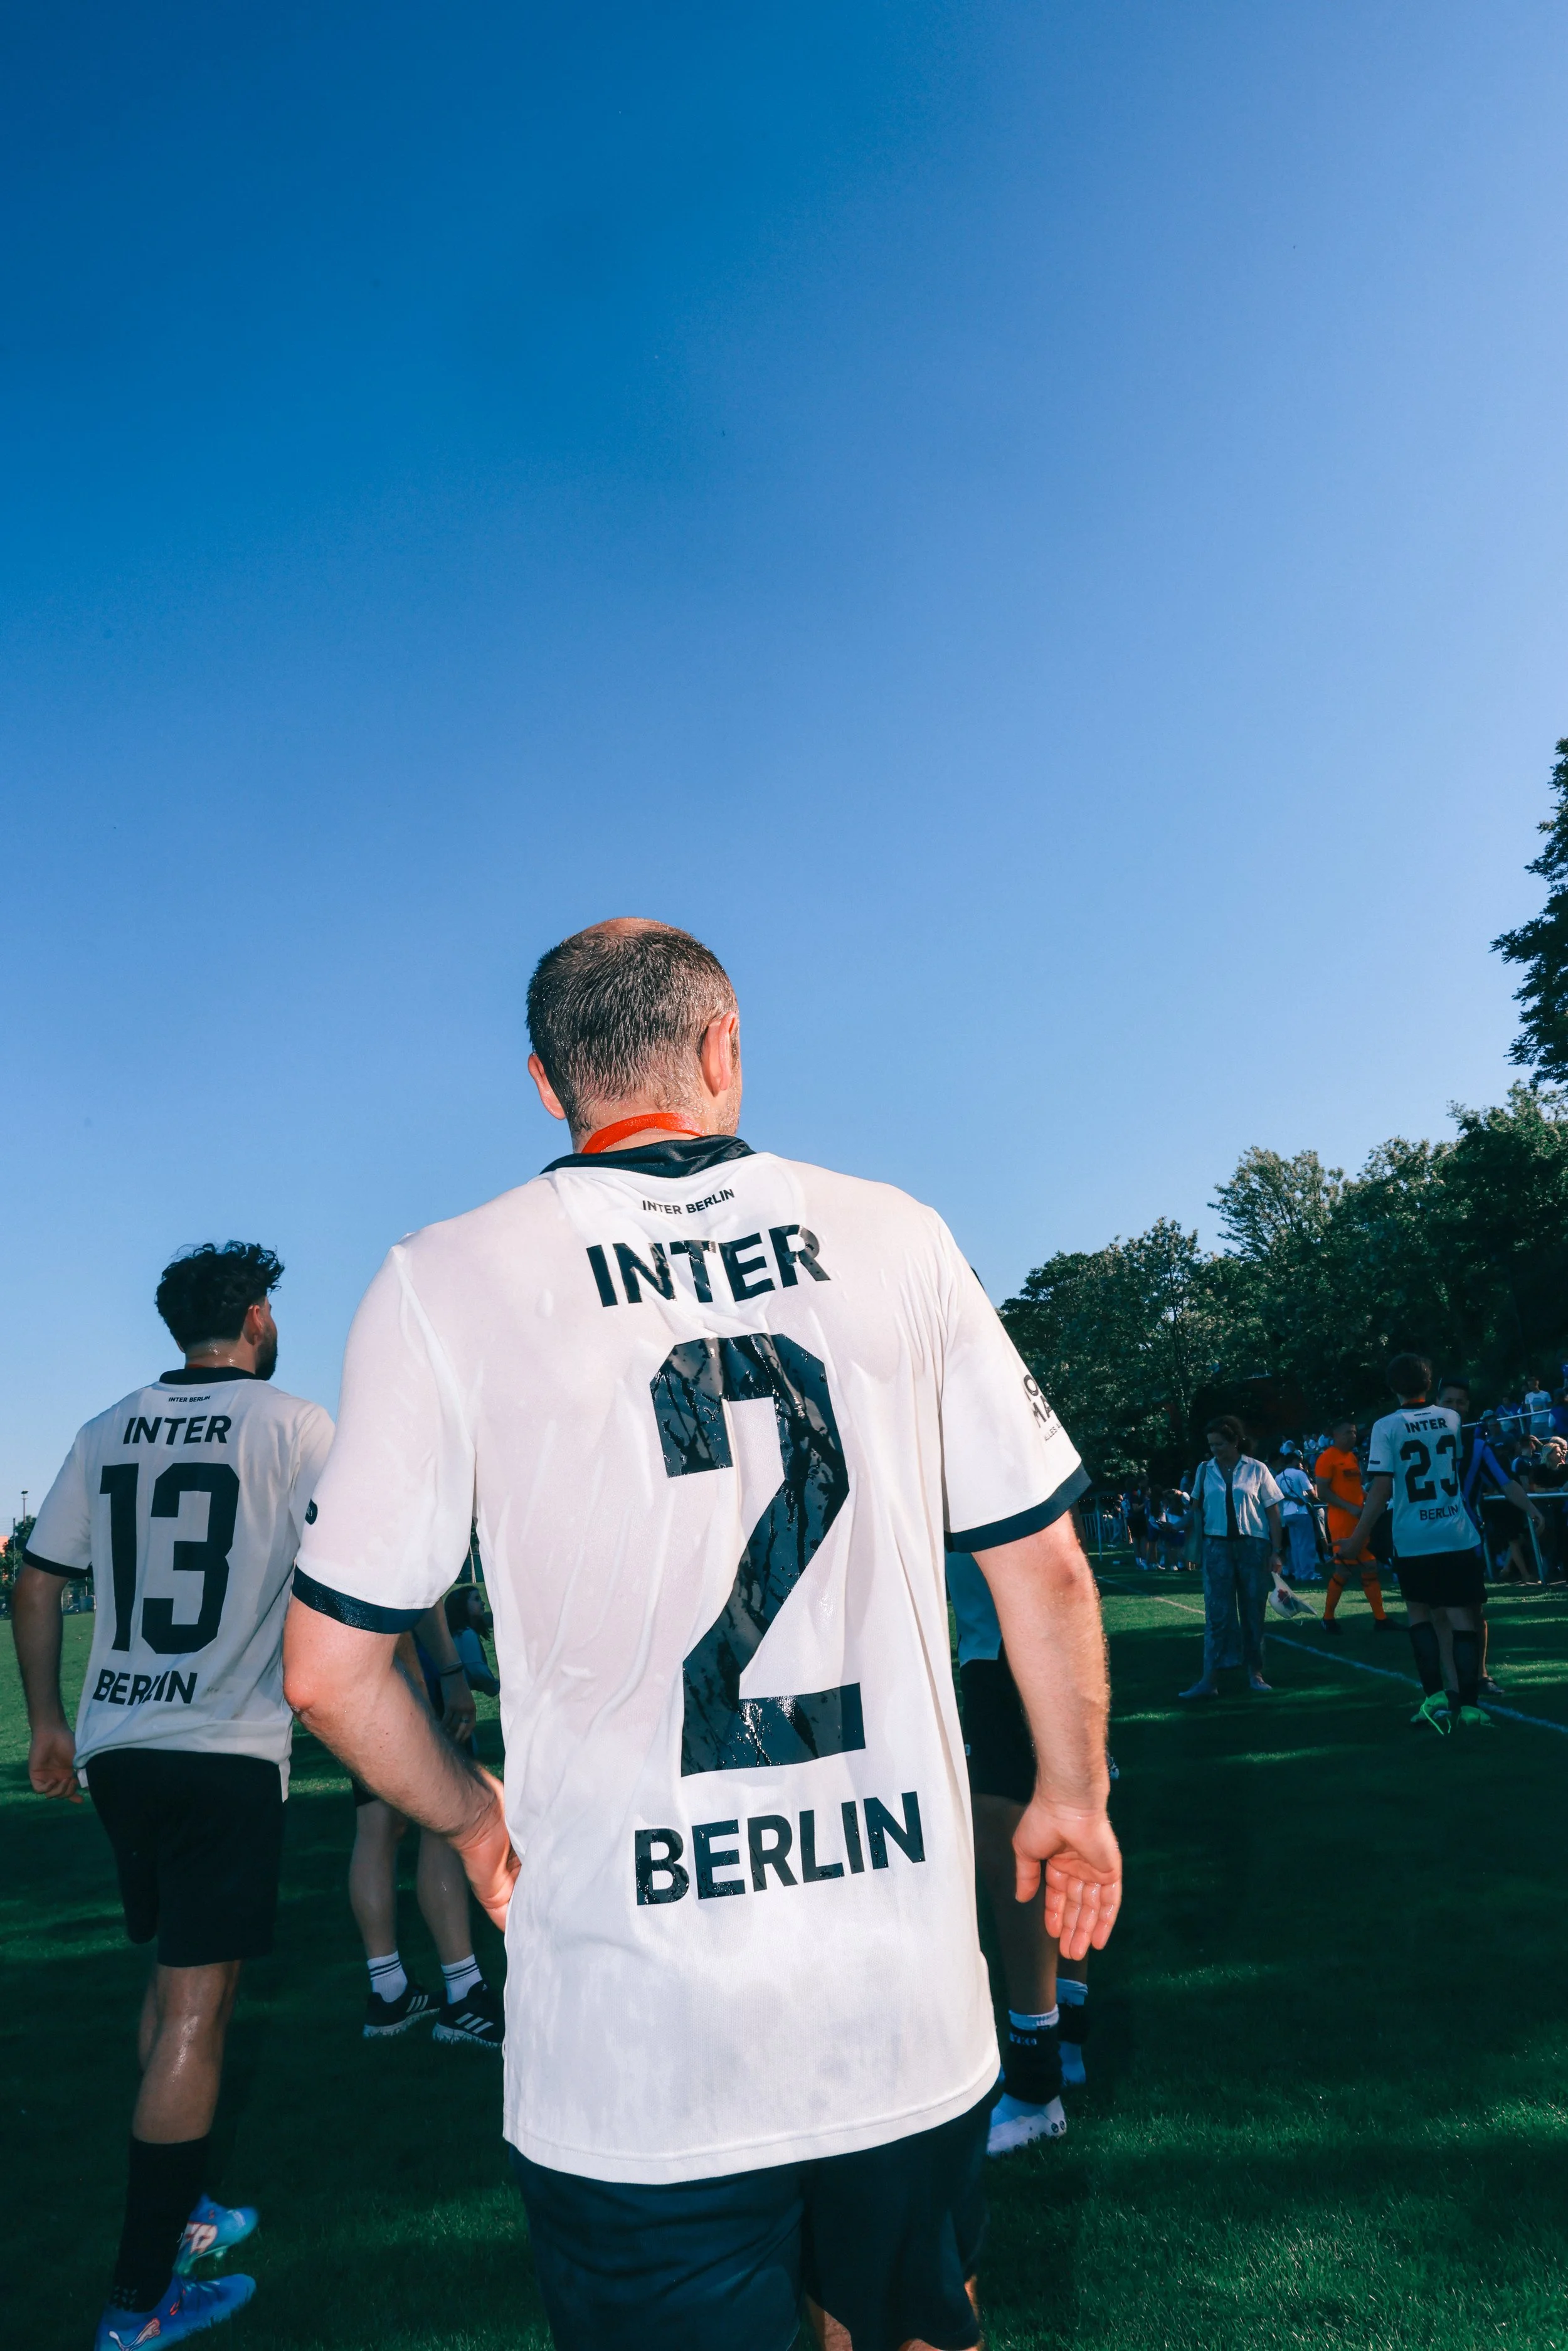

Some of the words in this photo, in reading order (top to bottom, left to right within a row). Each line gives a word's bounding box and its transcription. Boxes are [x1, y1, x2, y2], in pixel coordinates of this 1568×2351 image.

[642, 1200, 682, 1214] INTER
[686, 1189, 734, 1214] BERLIN
[586, 1224, 831, 1308] INTER
[123, 1415, 232, 1445] INTER
[1405, 1418, 1448, 1433] INTER
[1399, 1435, 1459, 1503] 23
[1419, 1505, 1458, 1521] BERLIN
[99, 1462, 240, 1655] 13
[649, 1332, 866, 1778] 2
[92, 1669, 198, 1706] BERLIN
[634, 1791, 926, 1906] BERLIN
